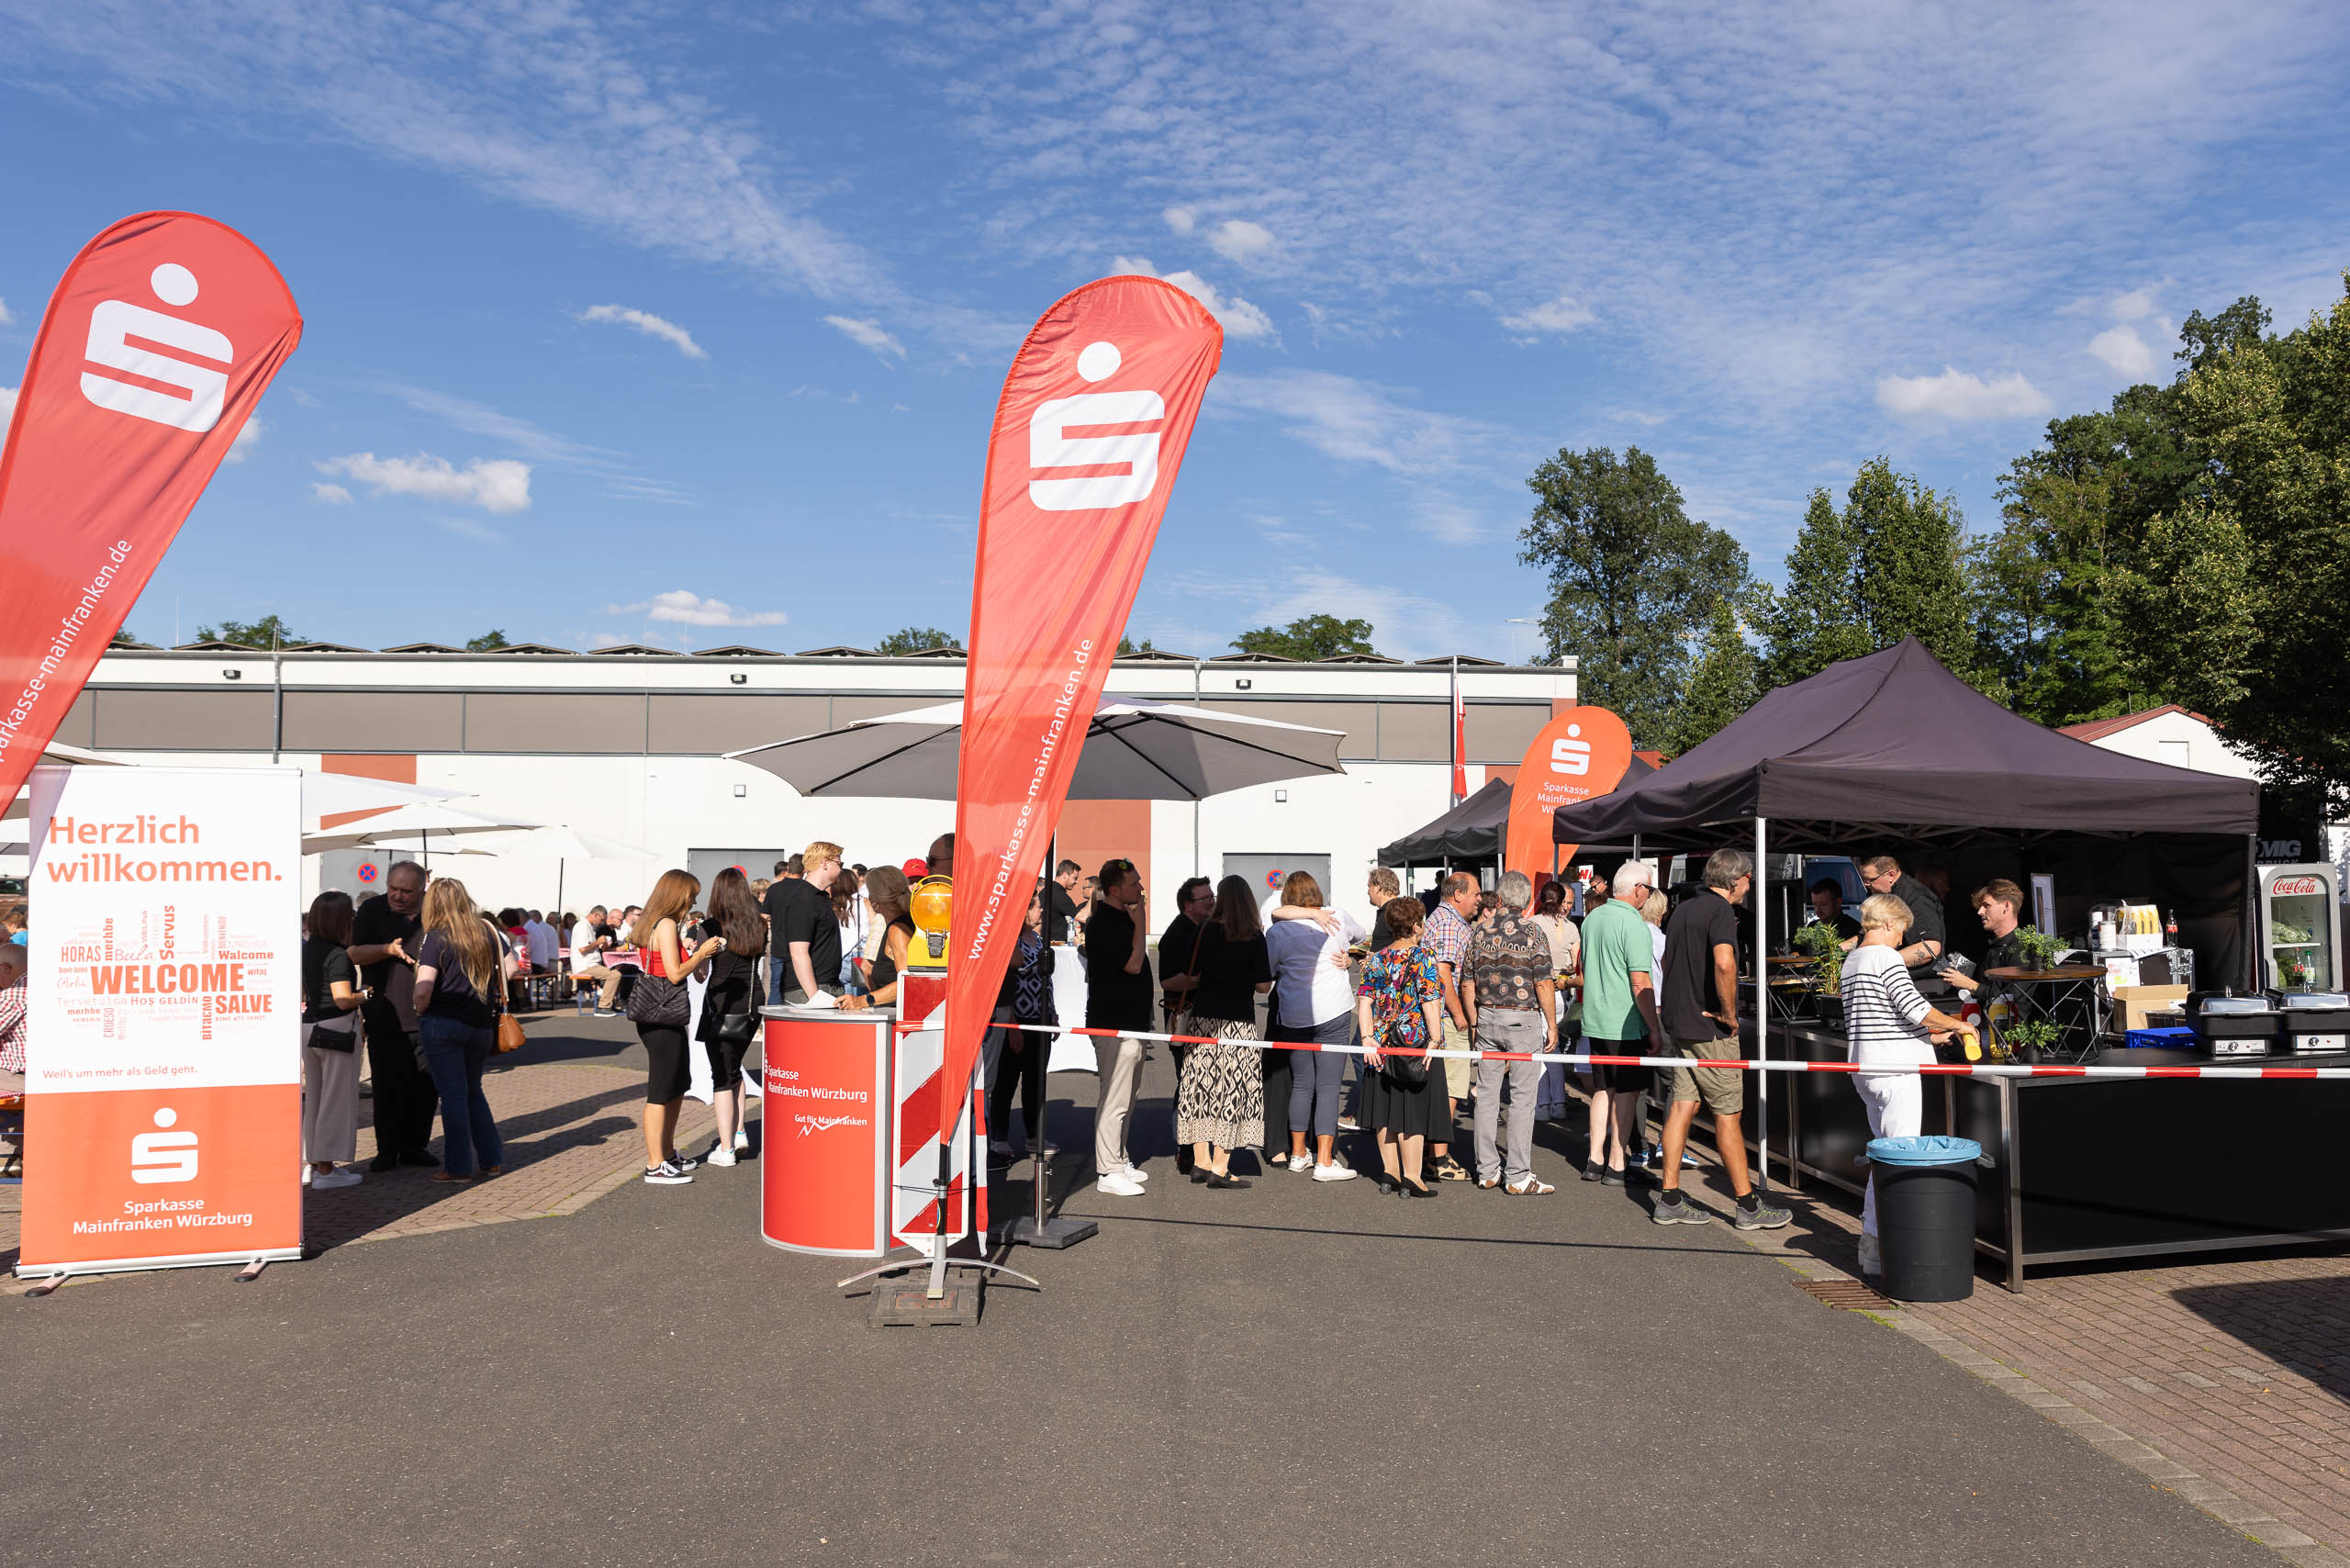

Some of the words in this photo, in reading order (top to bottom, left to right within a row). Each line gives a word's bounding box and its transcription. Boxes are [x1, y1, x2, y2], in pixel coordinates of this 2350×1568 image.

[1543, 781, 1590, 795] Sparkasse
[968, 638, 1093, 960] www.sparkasse-mainfranken.de
[50, 814, 199, 844] Herzlich
[47, 853, 283, 882] willkommen.
[159, 905, 175, 961] Servus
[61, 946, 102, 962] HORAS
[218, 950, 274, 959] Walcome
[90, 963, 244, 995] WELCOME
[215, 994, 273, 1014] SALVE
[95, 1068, 123, 1077] mehr
[127, 1066, 141, 1076] als
[144, 1065, 168, 1076] Geld
[768, 1065, 800, 1081] Sparkasse
[768, 1081, 808, 1097] Mainfranken
[811, 1087, 867, 1103] Würzburg
[794, 1114, 806, 1123] Gut
[807, 1114, 817, 1124] für
[818, 1115, 867, 1126] Mainfranken
[124, 1198, 205, 1216] Sparkasse
[73, 1216, 173, 1235] Mainfranken
[175, 1212, 252, 1227] Würzburg
